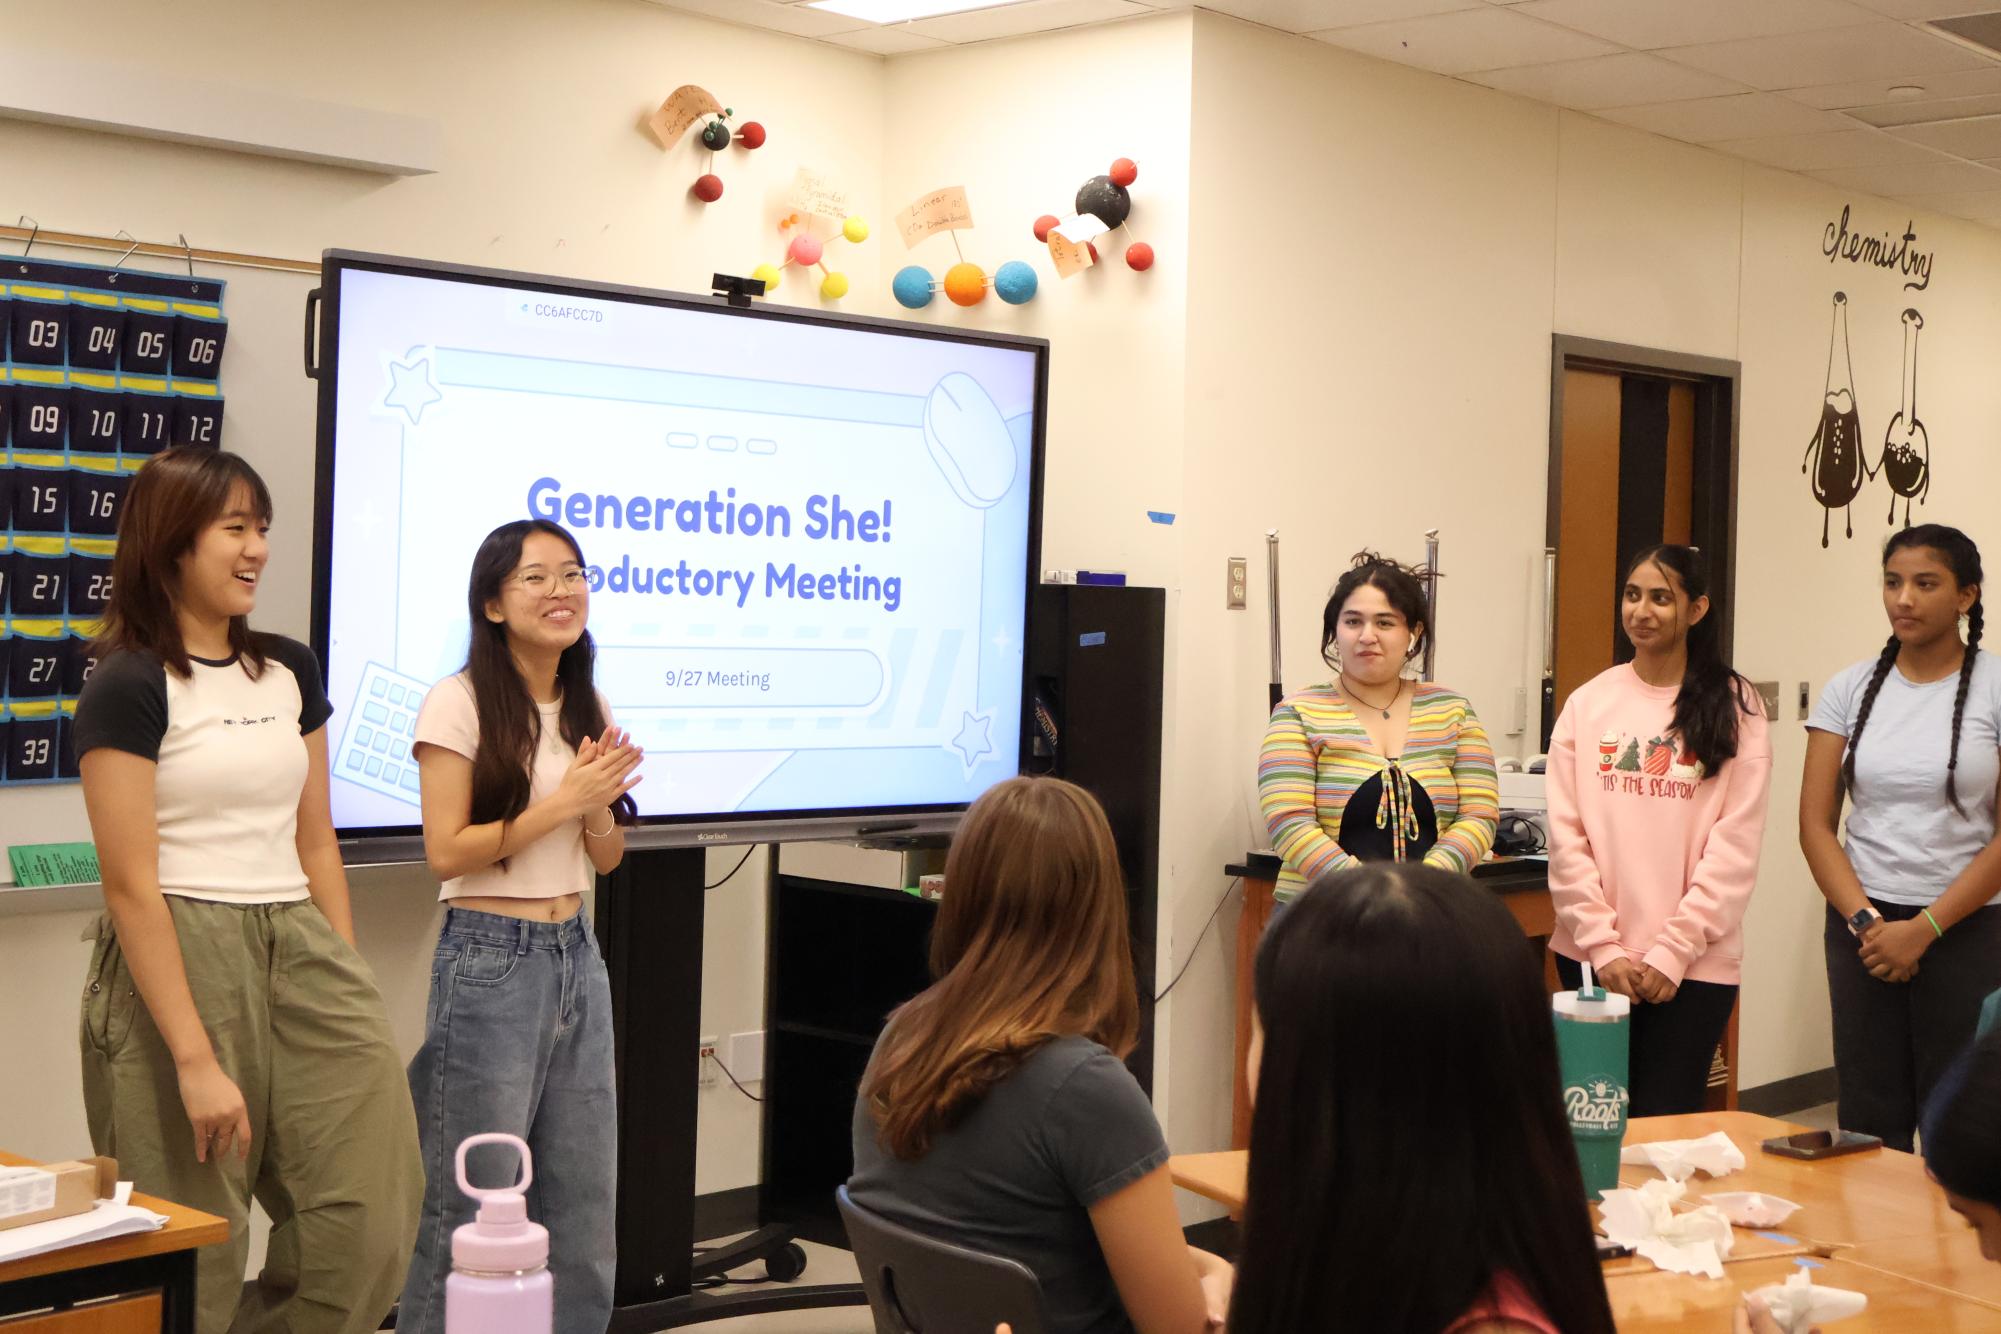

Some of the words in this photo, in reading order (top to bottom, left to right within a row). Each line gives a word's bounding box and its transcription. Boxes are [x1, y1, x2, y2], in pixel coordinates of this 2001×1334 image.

[535, 304, 603, 323] CC6AFCC7D
[29, 320, 59, 348] 03
[88, 326, 116, 355] 04
[137, 331, 165, 358] 05
[189, 337, 217, 364] 06
[30, 405, 59, 434] 09
[91, 409, 116, 437] 10
[141, 413, 164, 440] 11
[190, 415, 213, 443] 12
[32, 486, 57, 513] 15
[89, 490, 115, 517] 16
[527, 476, 791, 538] Generation
[804, 494, 892, 543] She!
[32, 575, 60, 600] 21
[87, 575, 114, 600] 22
[765, 561, 902, 612] Meeting
[29, 657, 57, 682] 27
[82, 657, 98, 681] 2
[665, 669, 702, 689] 9/27
[706, 670, 771, 691] Meeting
[22, 738, 50, 765] 33
[1623, 776, 1644, 795] THE
[1649, 778, 1697, 800] SEASON
[1564, 1086, 1629, 1130] Roots
